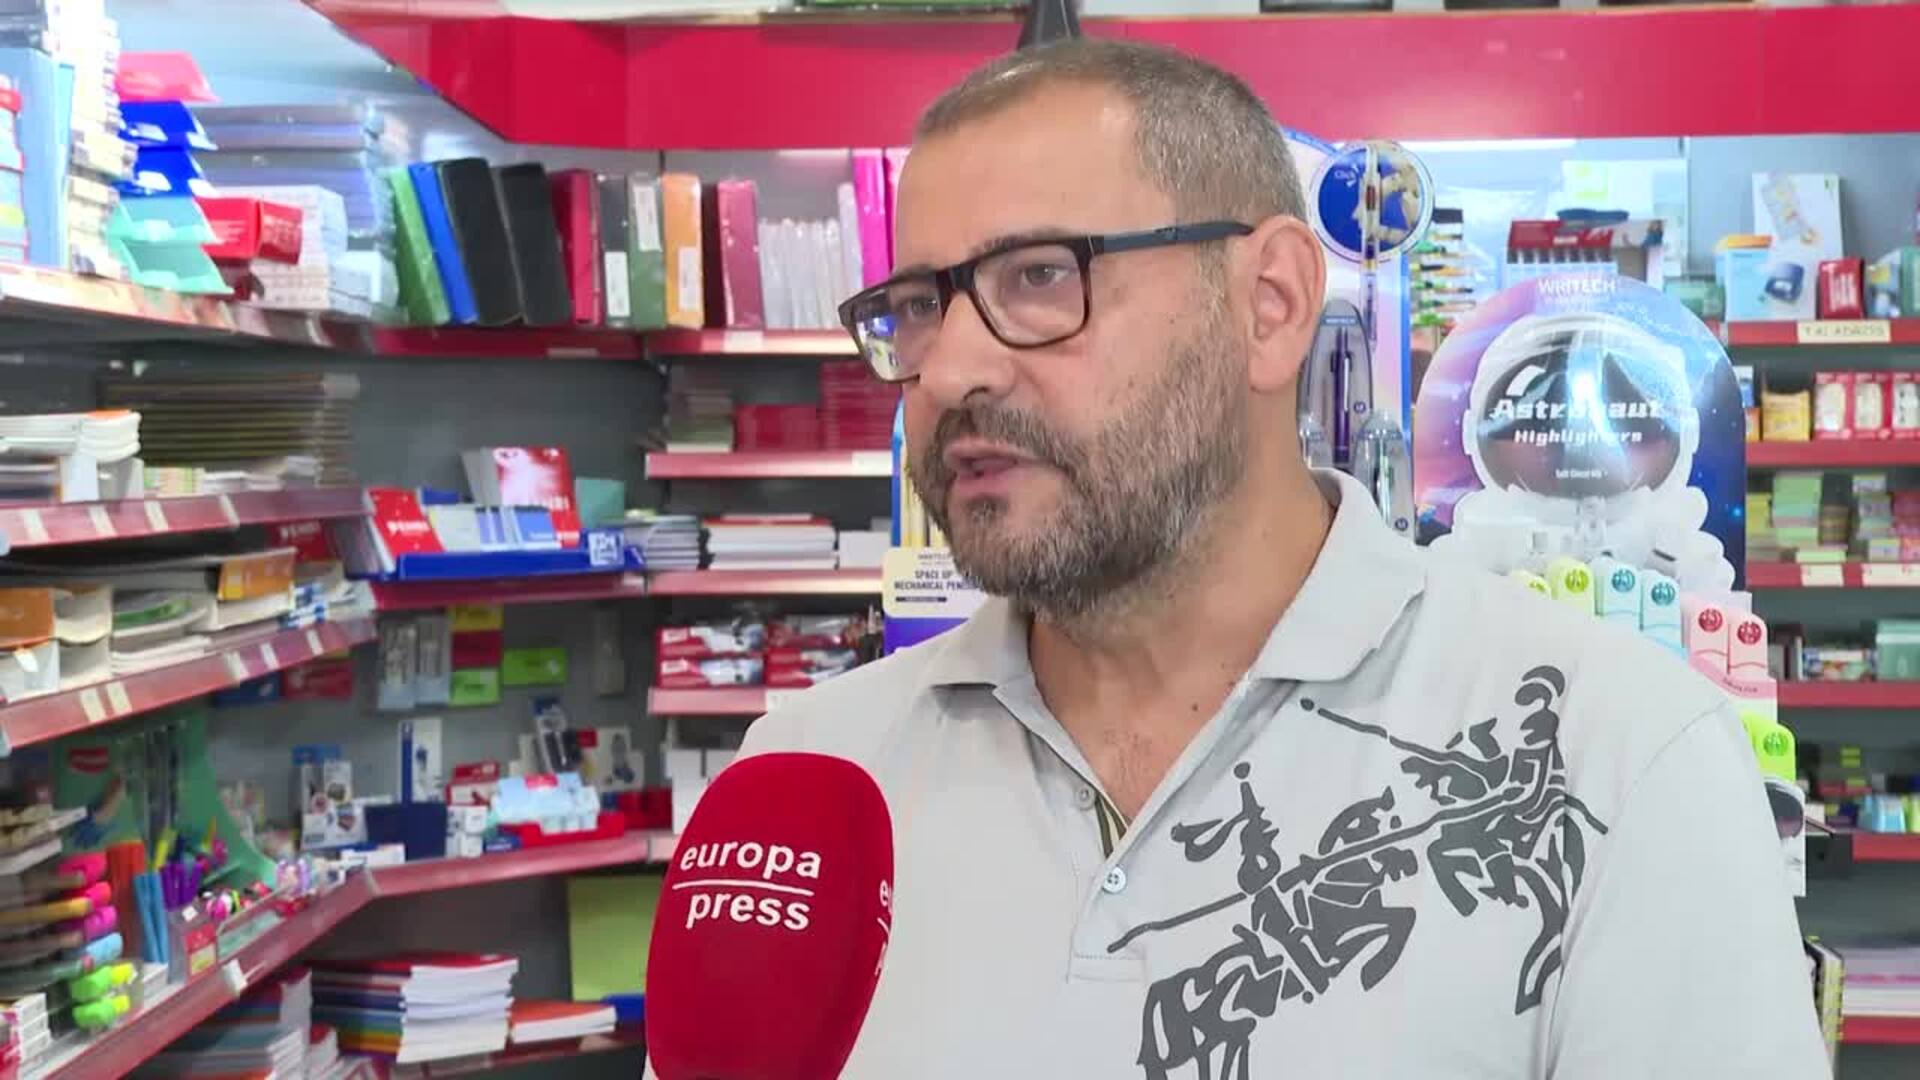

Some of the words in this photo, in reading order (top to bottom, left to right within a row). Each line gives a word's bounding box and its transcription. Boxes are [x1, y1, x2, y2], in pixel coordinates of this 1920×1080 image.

[1537, 278, 1617, 295] WRITECH
[679, 841, 822, 880] europa
[684, 892, 811, 931] press
